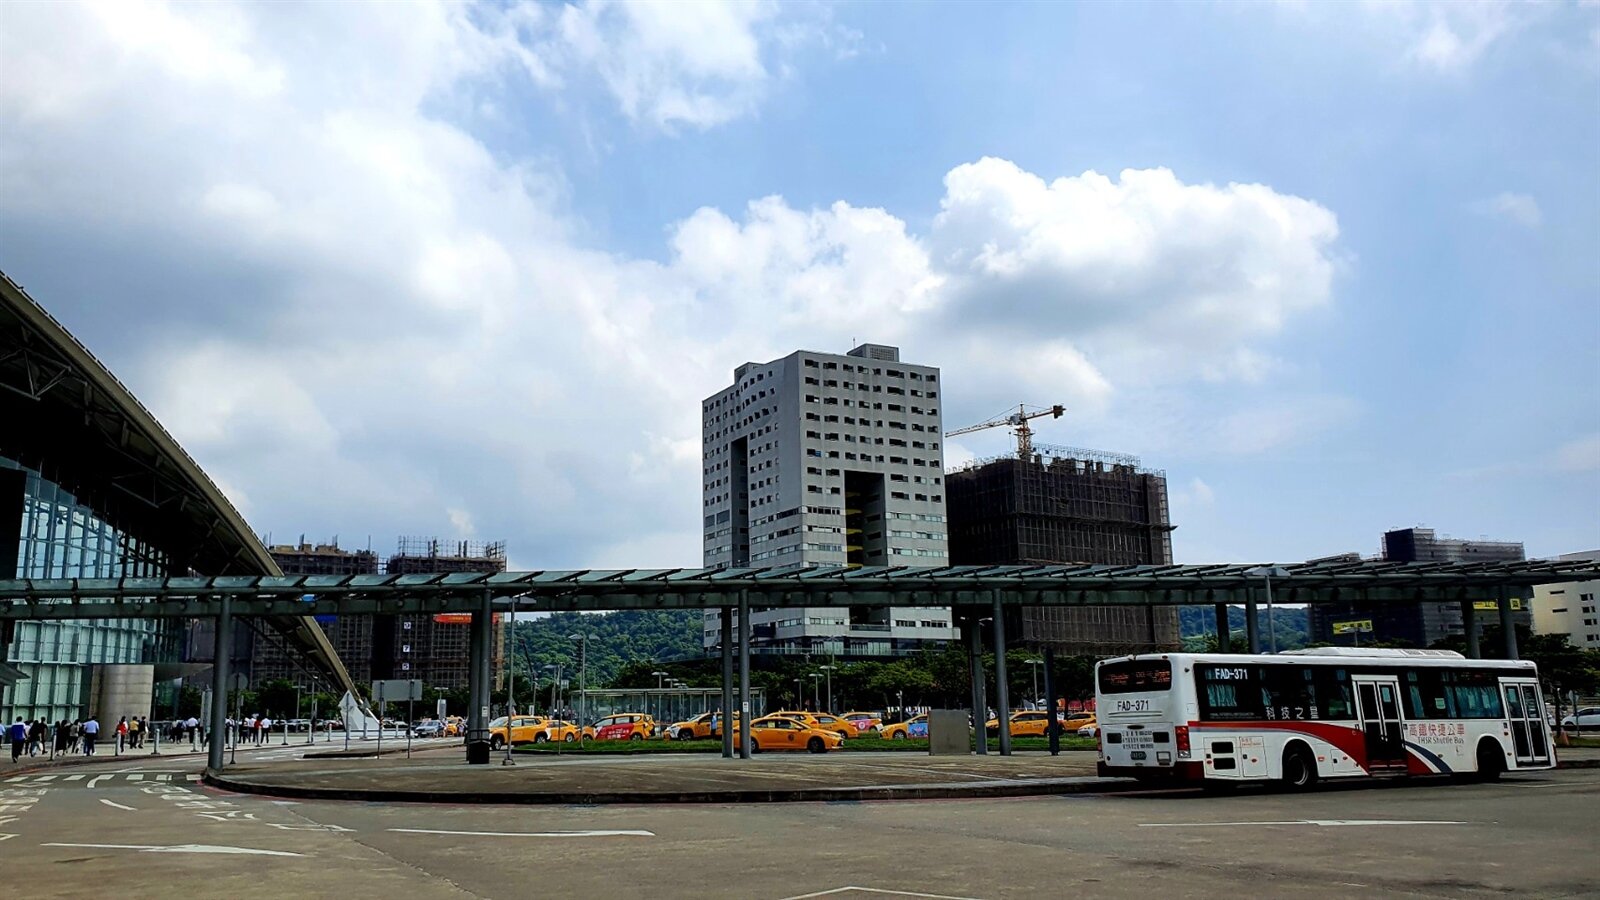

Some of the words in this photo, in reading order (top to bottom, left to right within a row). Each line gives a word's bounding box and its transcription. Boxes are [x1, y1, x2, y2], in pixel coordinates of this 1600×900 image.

[1214, 668, 1248, 680] FAD-371
[1117, 700, 1149, 711] FAD-371
[1409, 723, 1465, 736] 高鐵快捷公車
[1418, 736, 1432, 744] THSR
[1433, 736, 1453, 744] Shuttle
